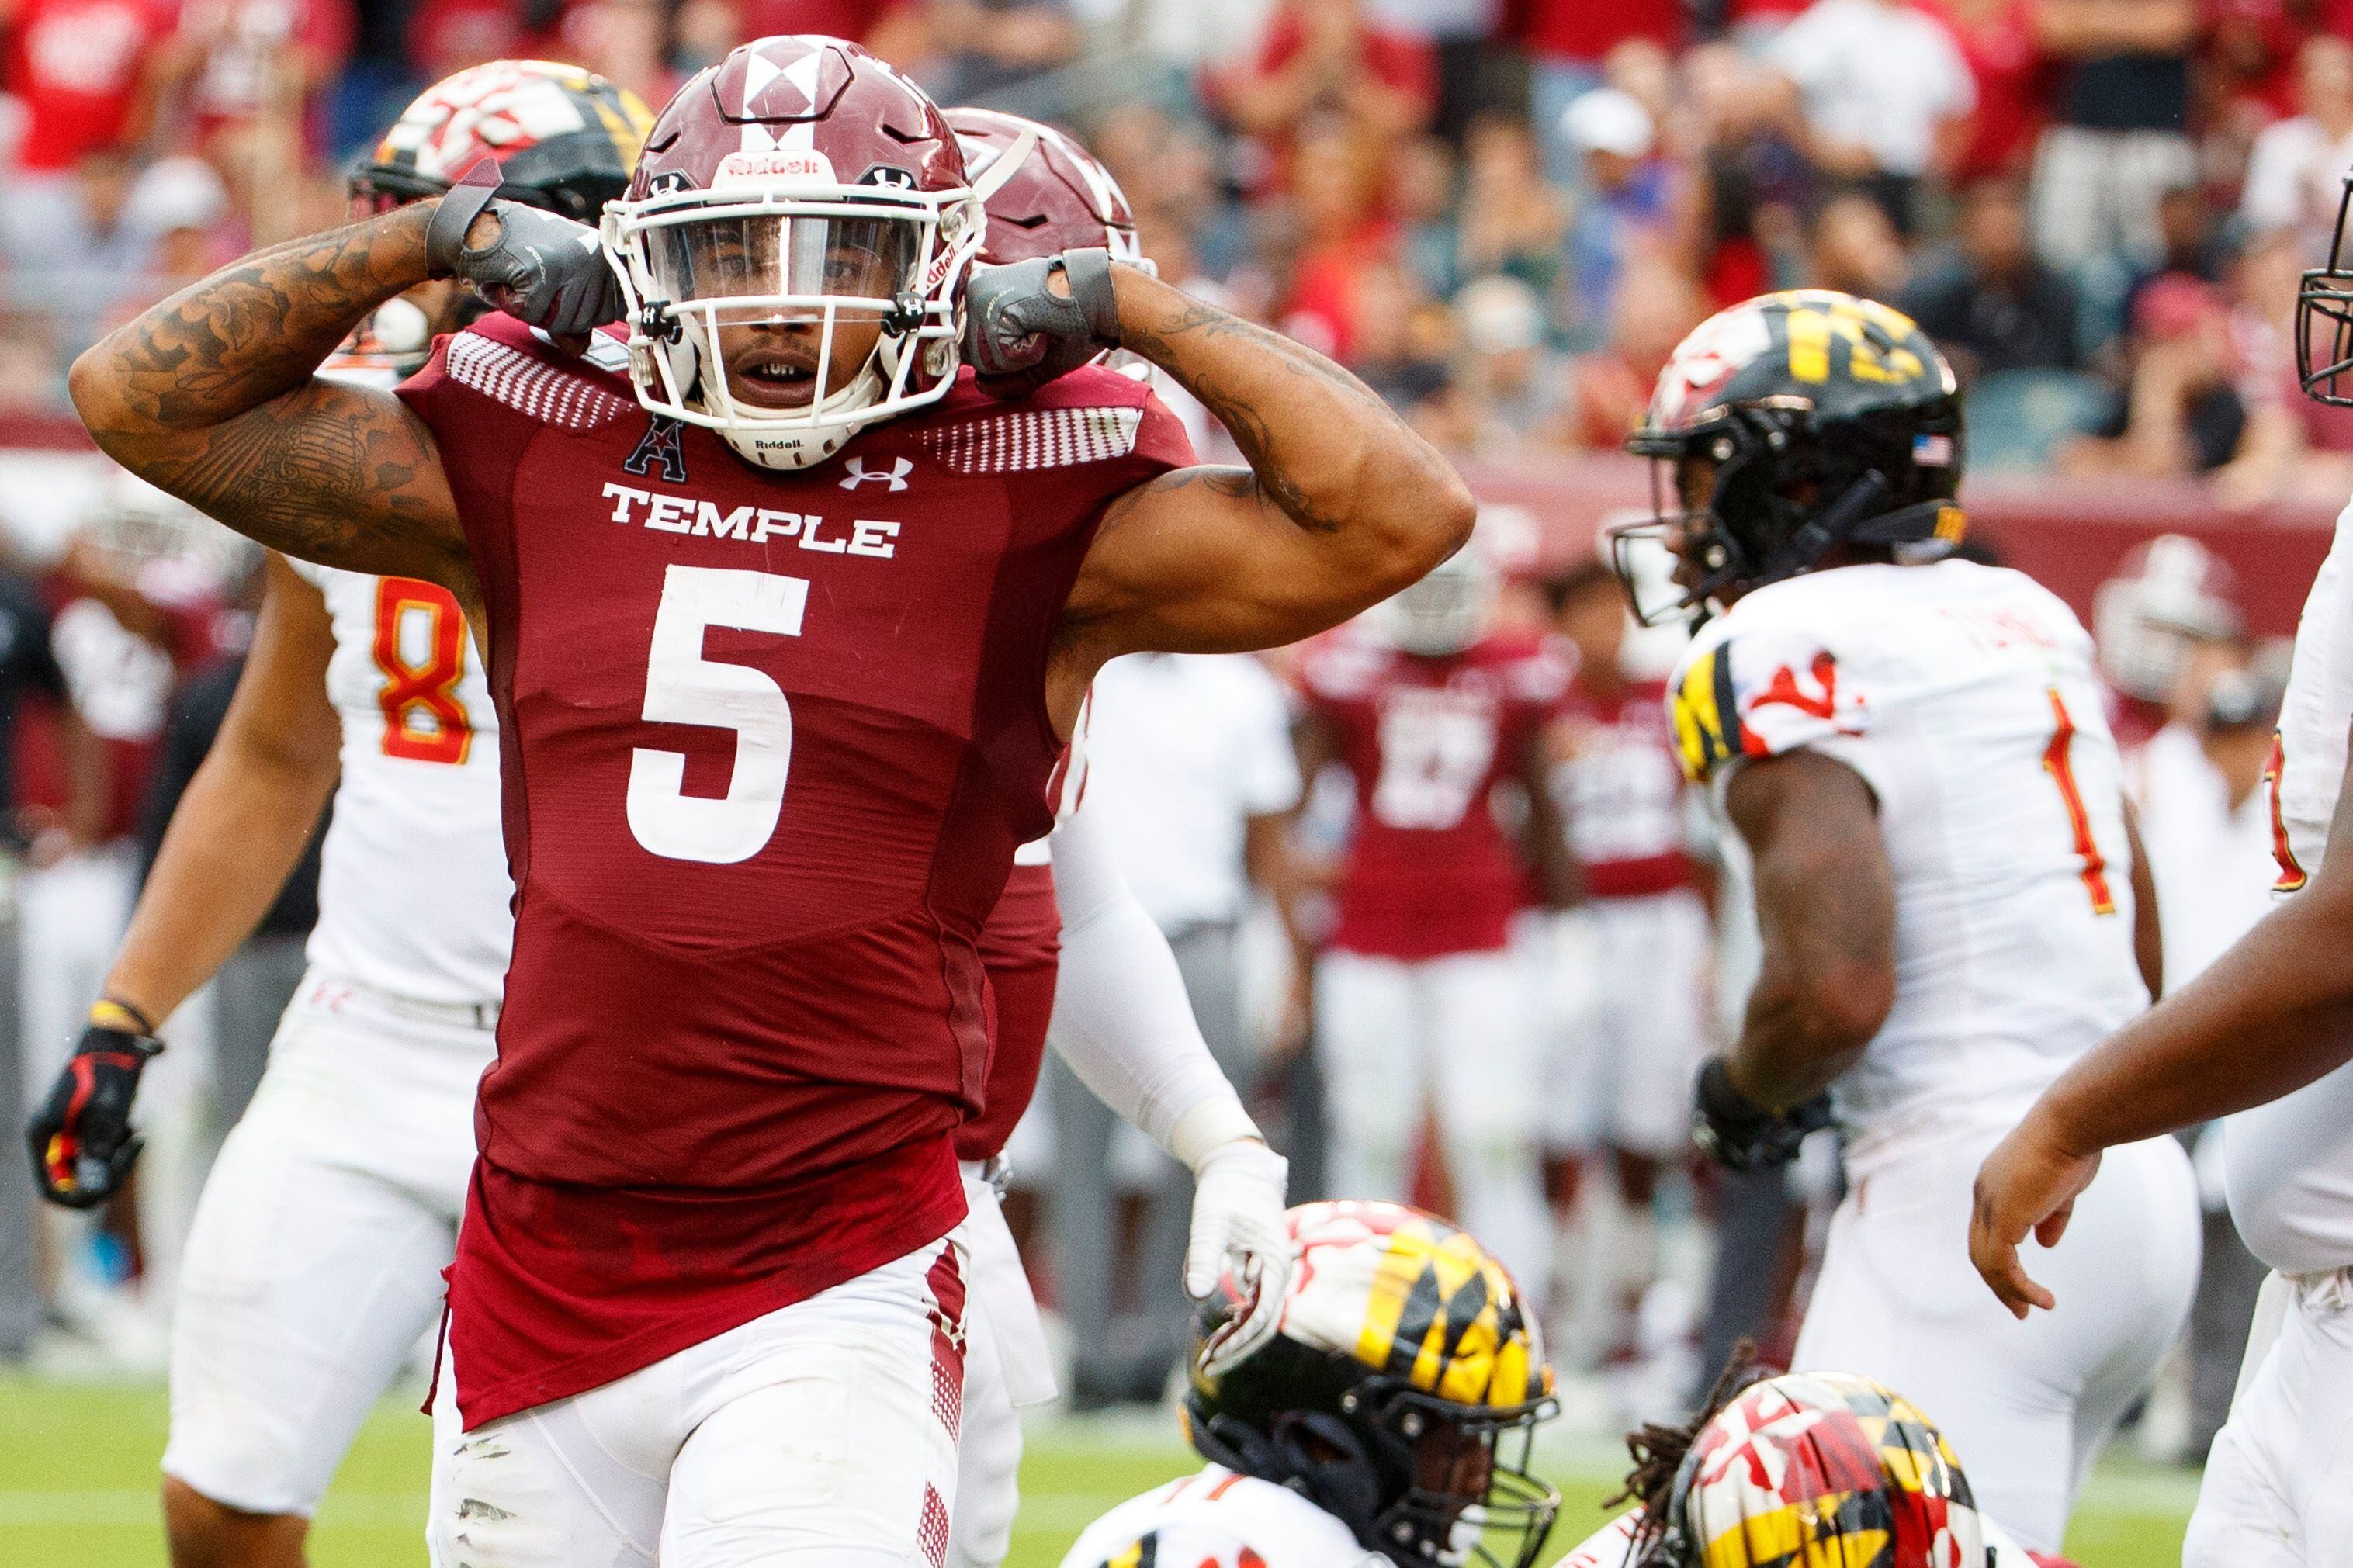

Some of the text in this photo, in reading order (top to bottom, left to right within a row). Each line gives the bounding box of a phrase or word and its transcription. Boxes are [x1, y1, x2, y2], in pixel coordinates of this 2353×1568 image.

[602, 482, 901, 559] TEMPLE
[755, 439, 801, 449] Riddell
[373, 575, 475, 765] 8
[626, 563, 810, 864] 5
[2041, 687, 2116, 910] 1
